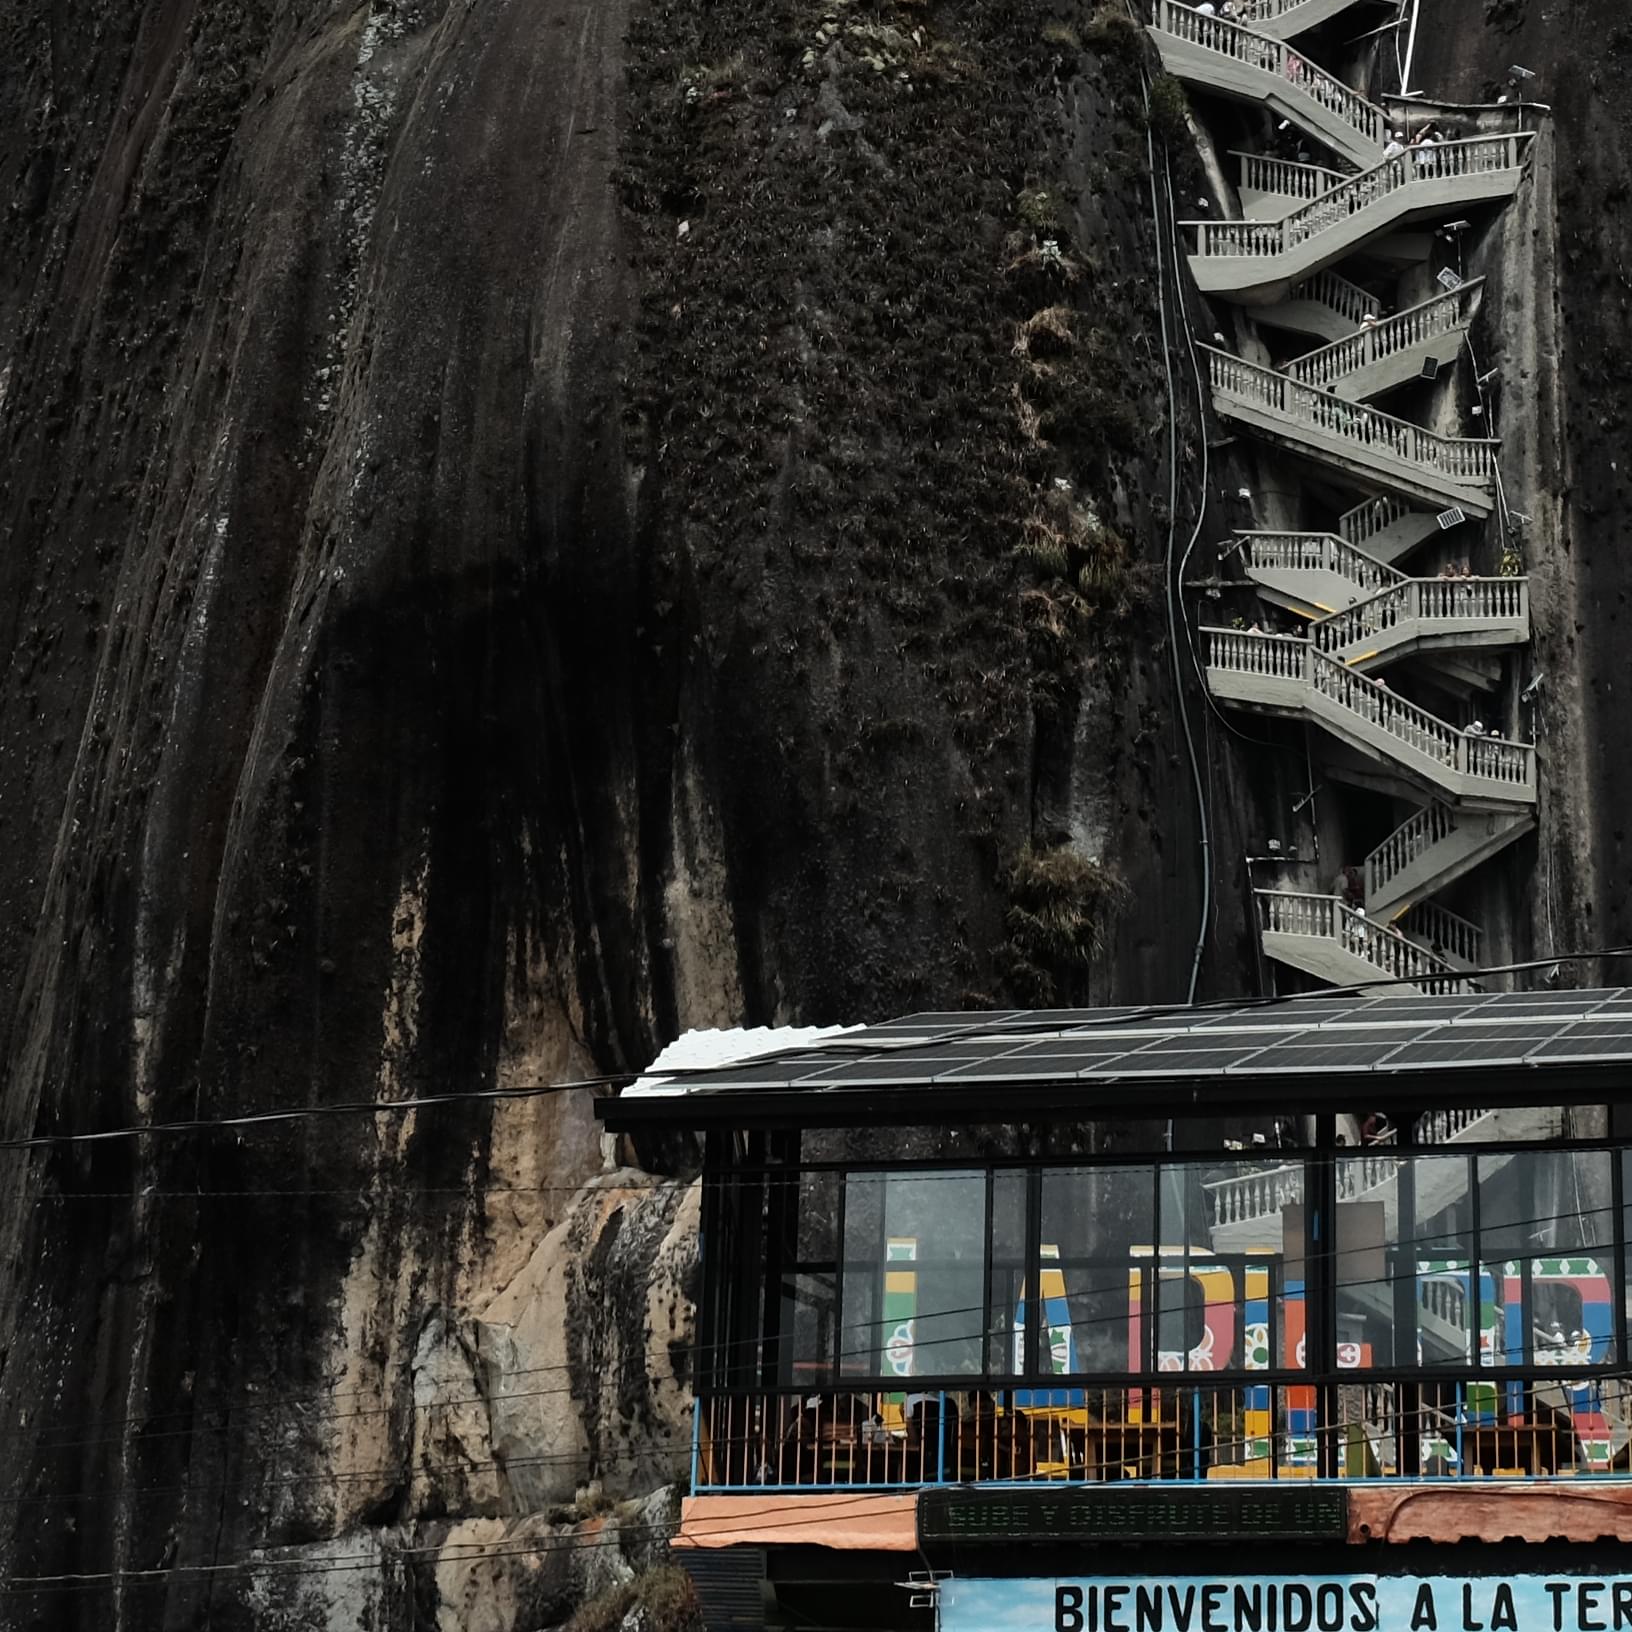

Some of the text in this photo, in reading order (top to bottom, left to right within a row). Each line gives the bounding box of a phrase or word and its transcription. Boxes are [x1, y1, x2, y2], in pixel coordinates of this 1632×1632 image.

[1055, 1583, 1377, 1632] BIENVENIDOS
[1410, 1582, 1439, 1632] A
[1462, 1582, 1518, 1632] LA
